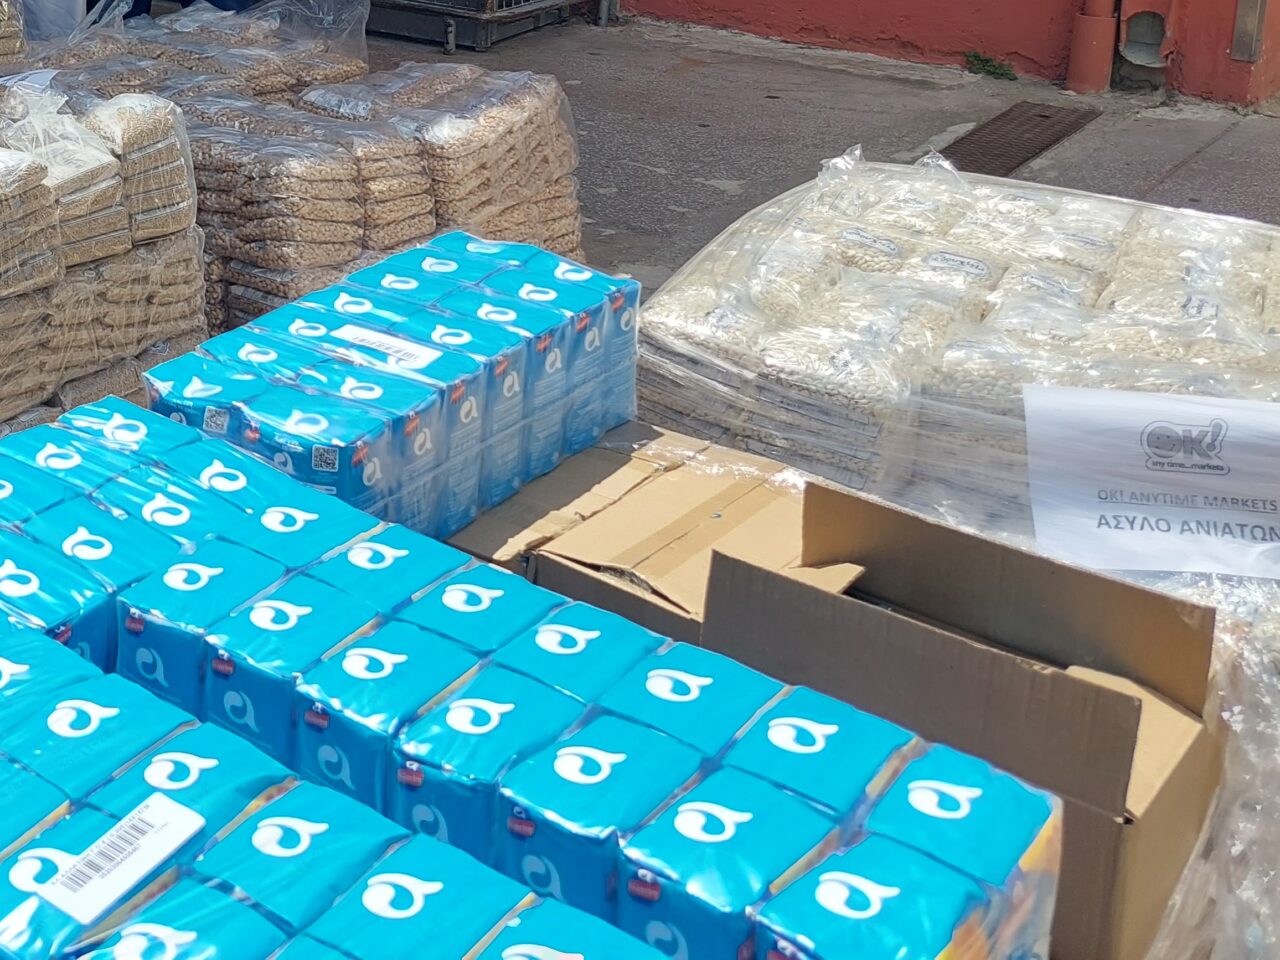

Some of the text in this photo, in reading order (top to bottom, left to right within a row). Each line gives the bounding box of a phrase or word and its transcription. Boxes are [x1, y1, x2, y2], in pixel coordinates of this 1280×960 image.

[1097, 489, 1278, 511] OK! ANYTIME MARKETS
[1096, 514, 1172, 533] ΑΣΥΛΟ
